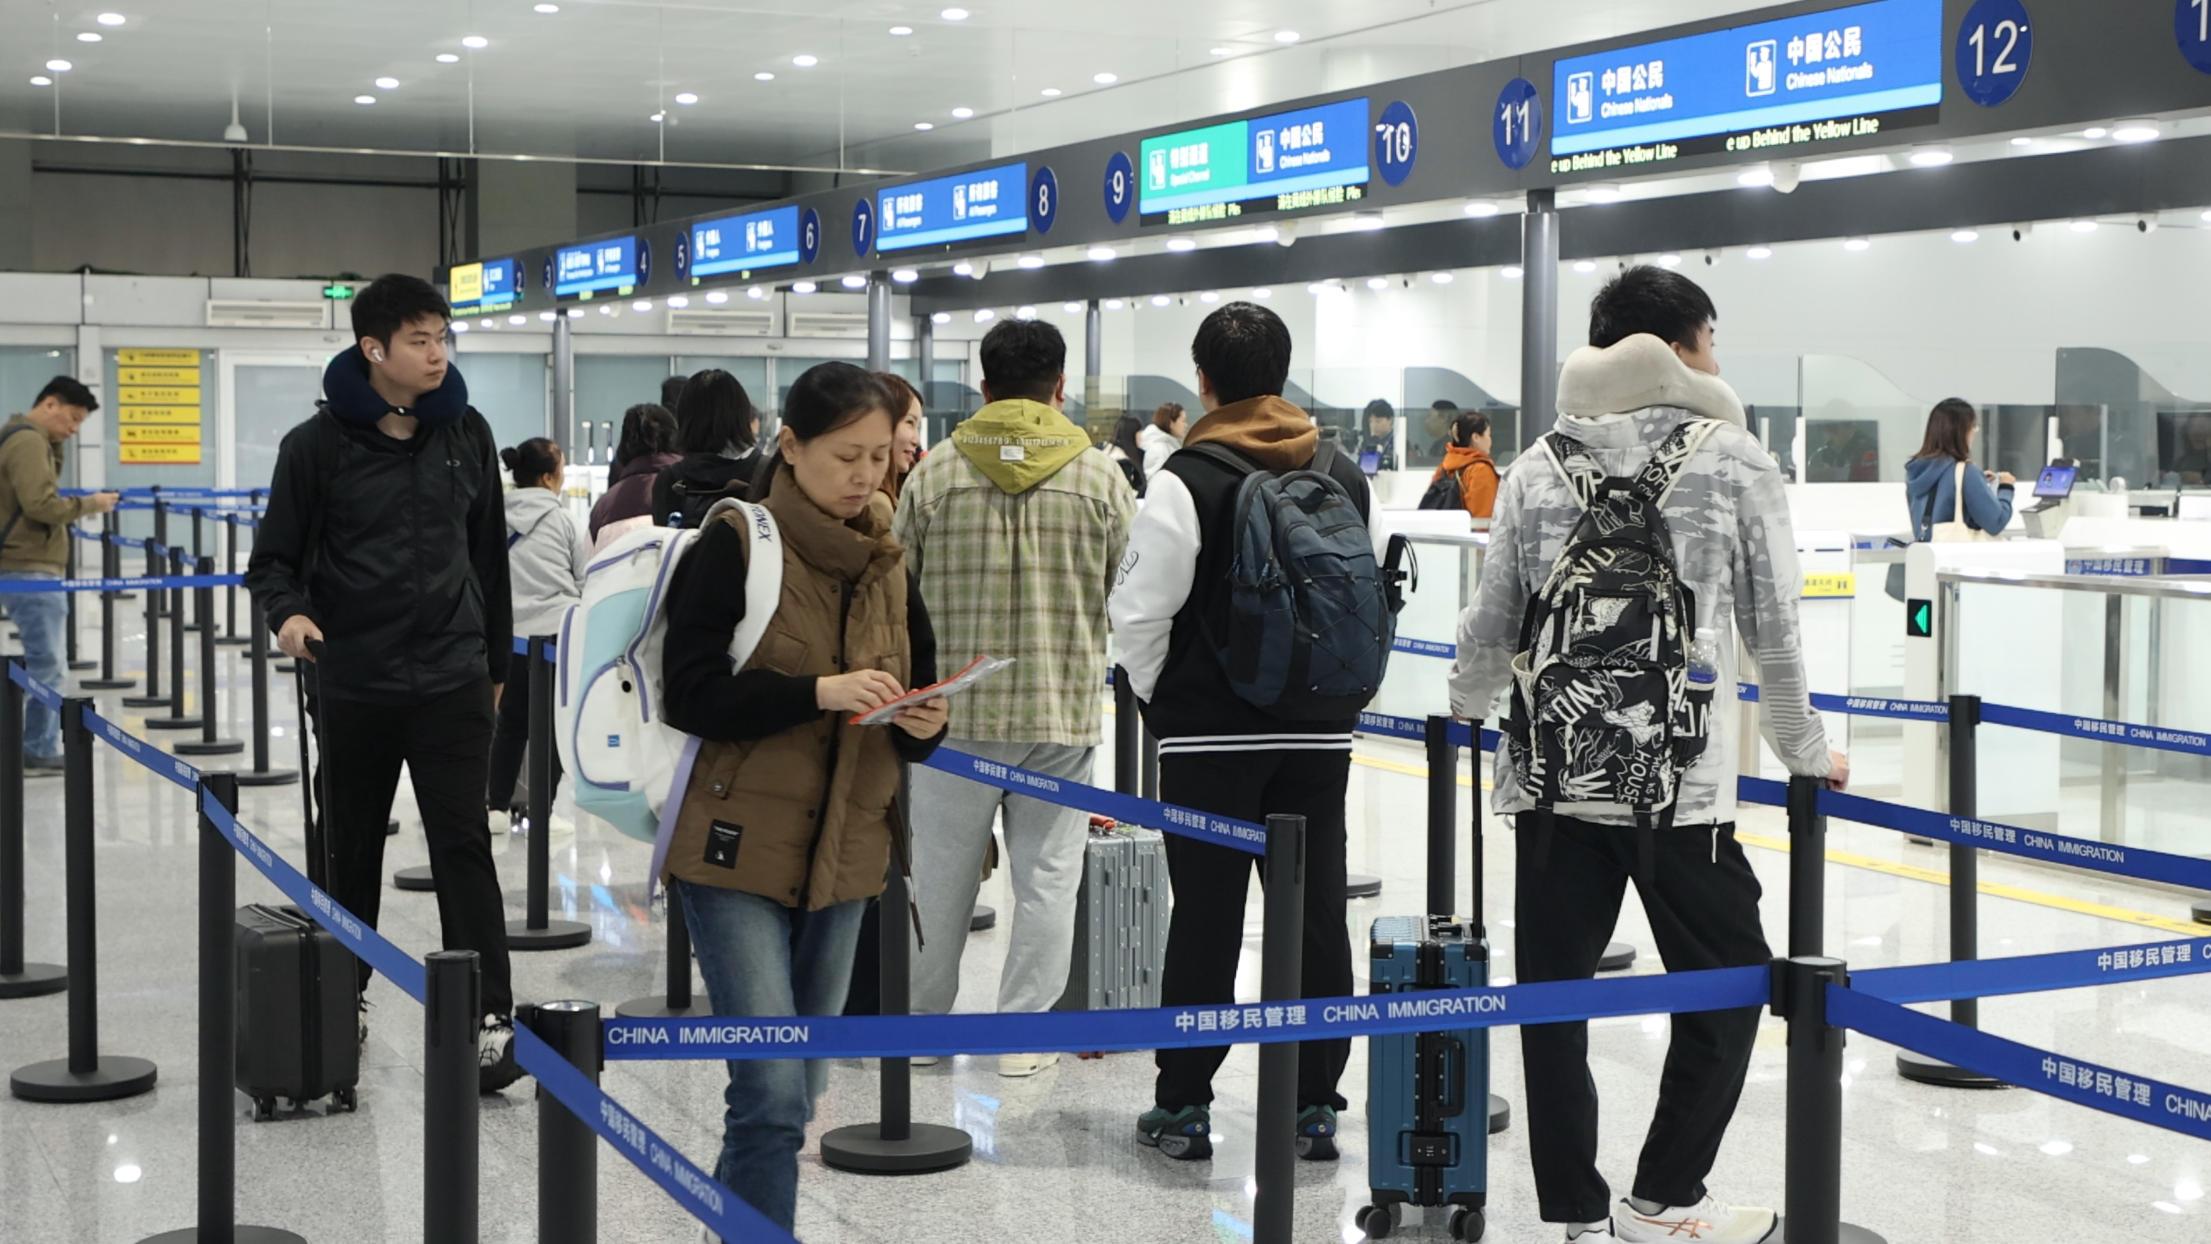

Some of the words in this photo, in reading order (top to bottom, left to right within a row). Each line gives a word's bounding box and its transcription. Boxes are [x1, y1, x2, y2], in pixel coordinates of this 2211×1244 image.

[1786, 25, 1862, 67] 中国公民
[1968, 19, 2018, 77] 12
[1601, 60, 1664, 97] 中国公民
[1785, 71, 1826, 91] Chinese
[1826, 61, 1874, 85] Nationals
[1600, 101, 1634, 119] Chinese
[1634, 93, 1674, 115] Nationals
[1501, 100, 1530, 146] 11
[1752, 126, 1790, 148] Behind
[1792, 125, 1812, 143] the
[1813, 119, 1852, 141] Yellow
[1853, 117, 1880, 136] Line
[1382, 122, 1411, 165] 10
[1572, 151, 1605, 171] Behind
[1605, 149, 1622, 167] the
[1621, 145, 1655, 165] Yellow
[1655, 143, 1679, 161] Line
[1039, 184, 1049, 217] 8
[1113, 170, 1125, 205] 9
[806, 222, 814, 250] 6
[858, 213, 867, 242] 7
[640, 256, 647, 275] 4
[678, 244, 685, 270] 5
[1890, 702, 1908, 712] CHINA
[1909, 703, 1949, 715] IMMIGRATION
[2130, 727, 2155, 740] CHINA
[2156, 730, 2207, 748] IMMIGRATION
[1009, 770, 1026, 785] CHINA
[1026, 774, 1060, 793] IMMIGRATION
[1620, 749, 1653, 804] HOUSE
[1210, 820, 1231, 836] CHINA
[1949, 818, 2016, 844] 中国移民管理
[2024, 833, 2055, 852] CHINA
[2057, 840, 2125, 865] IMMIGRATION
[2097, 943, 2192, 972] 中国移民管理
[1174, 1004, 1308, 1034] 中国移民管理
[1323, 1002, 1380, 1025] CHINA
[1387, 994, 1507, 1020] IMMIGRATION
[607, 1026, 669, 1045] CHINA
[679, 1025, 809, 1045] IMMIGRATION
[2041, 1056, 2152, 1108] 中国移民管理
[649, 1141, 673, 1177] CHINA
[673, 1159, 724, 1217] IMMIGRATION
